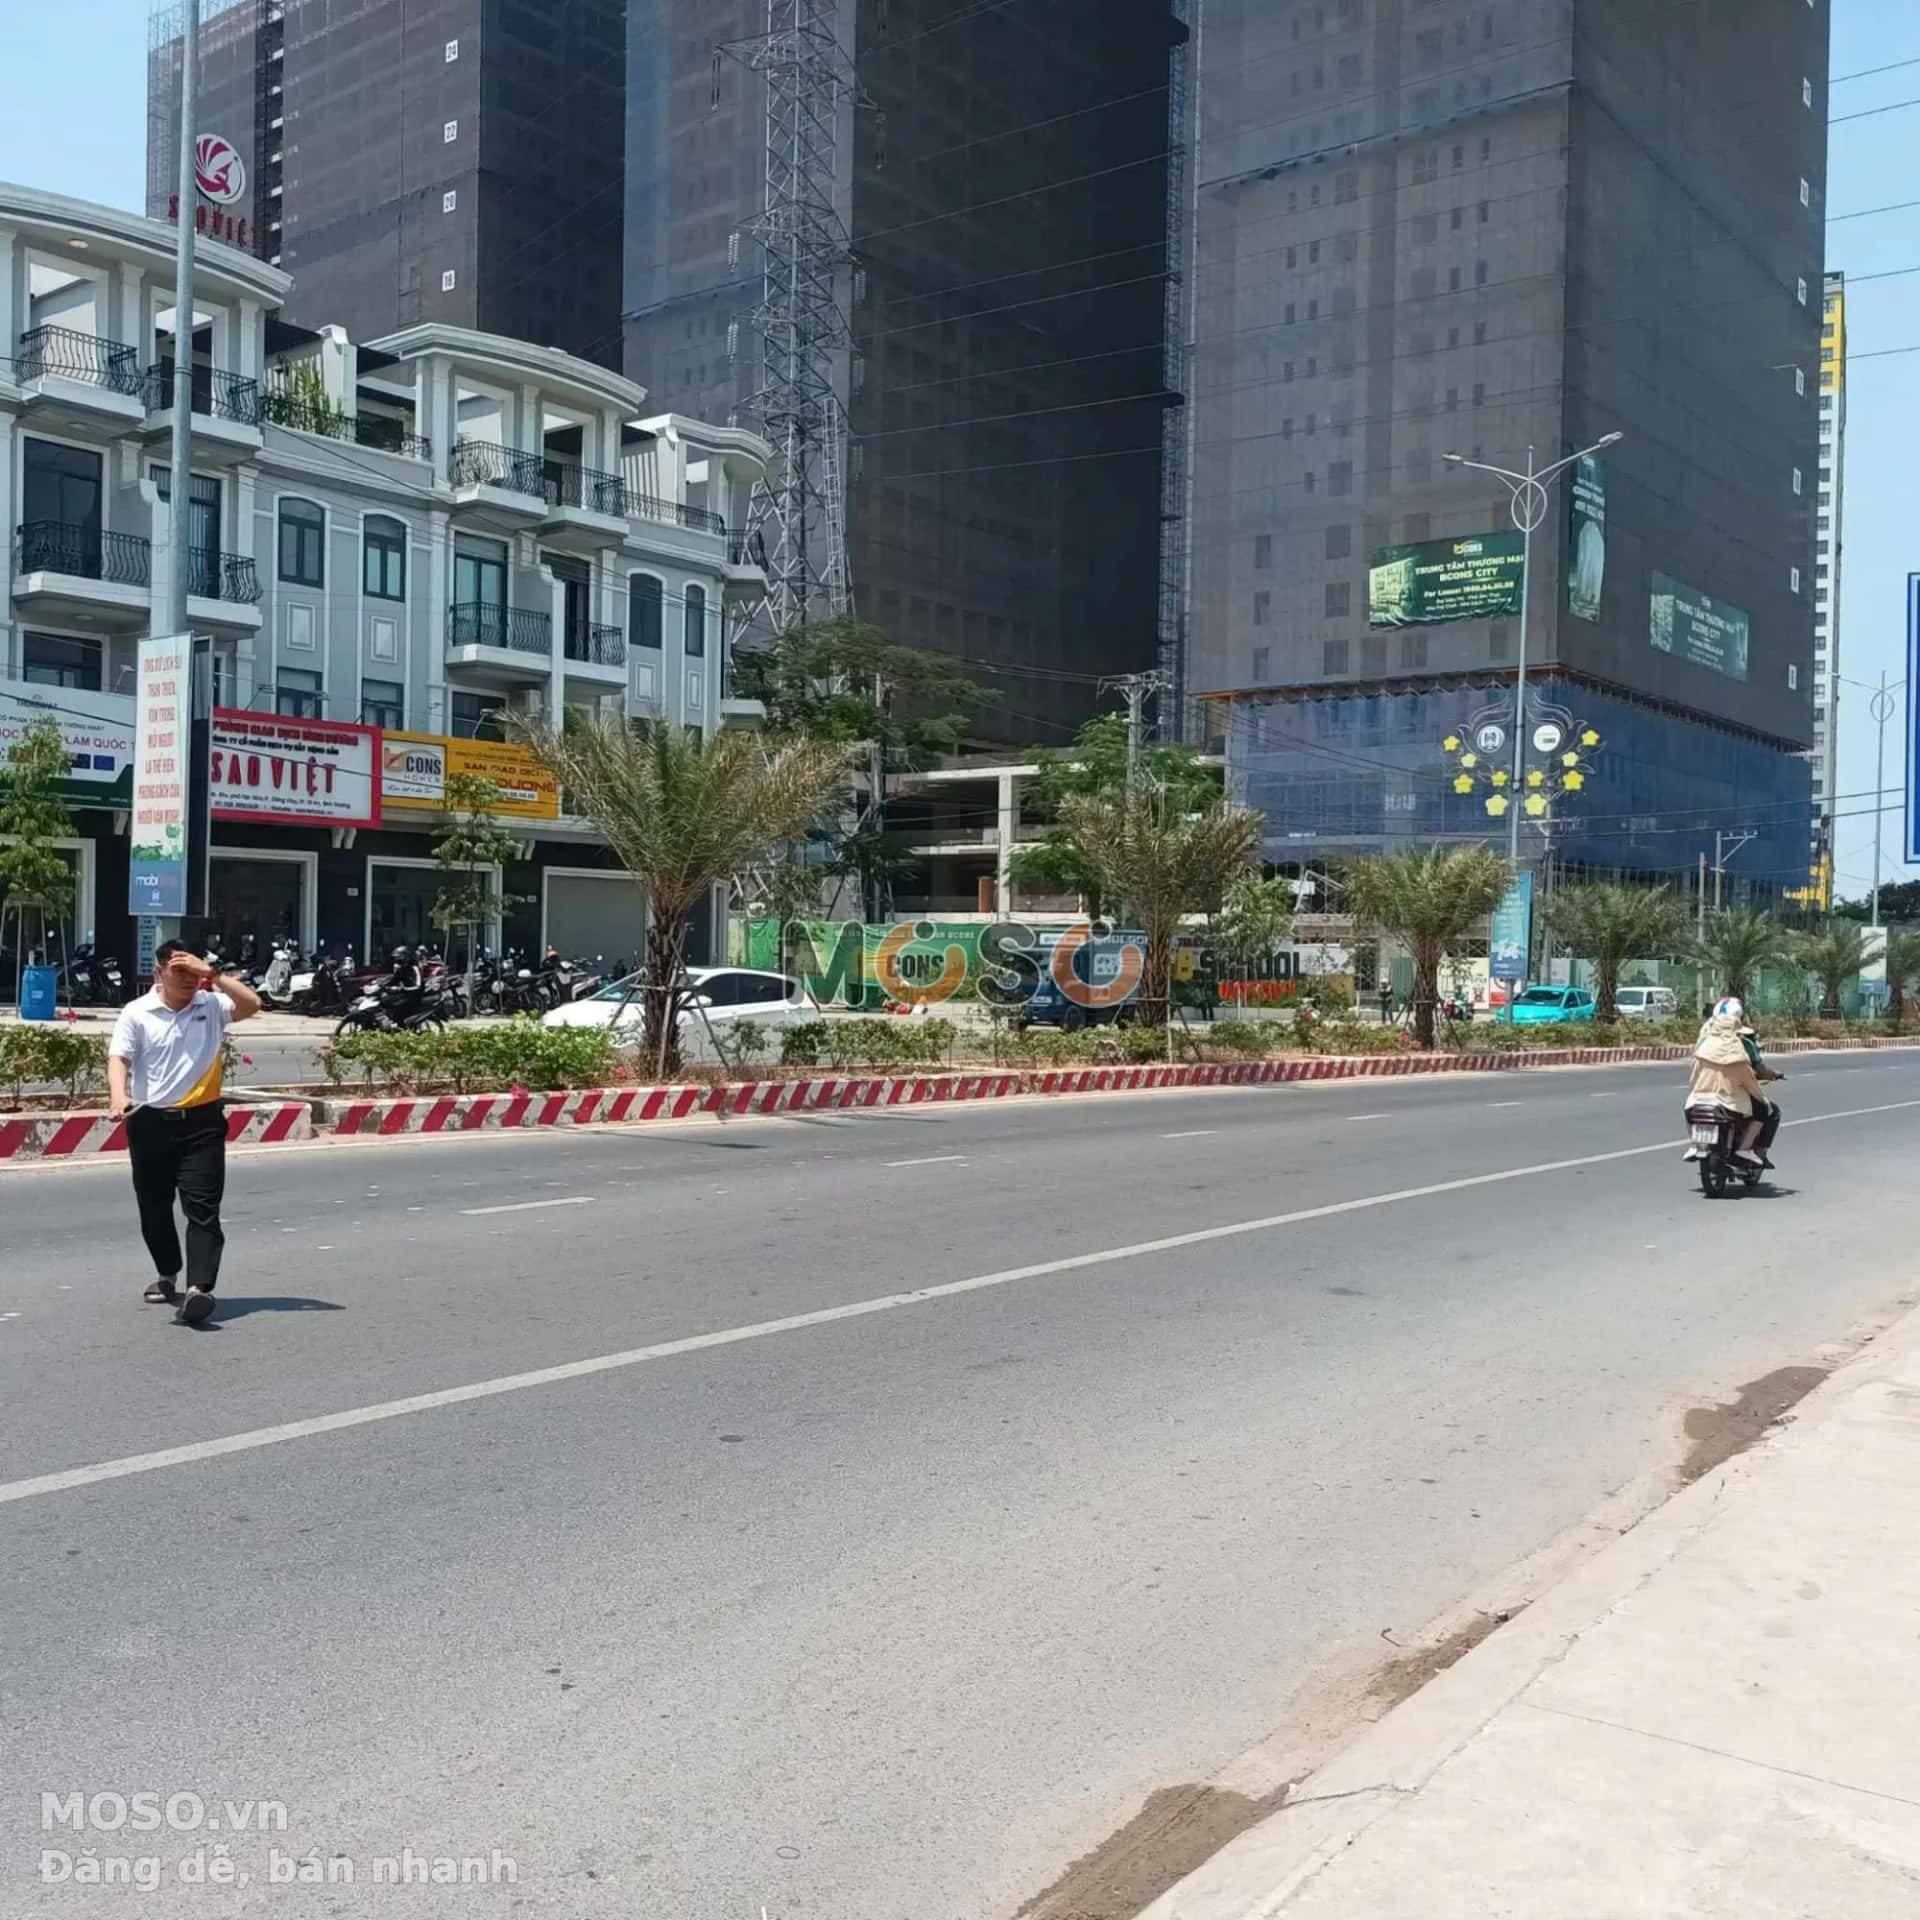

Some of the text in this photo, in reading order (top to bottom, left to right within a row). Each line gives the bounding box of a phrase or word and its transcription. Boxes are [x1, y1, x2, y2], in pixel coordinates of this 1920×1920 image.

[169, 194, 207, 234] SO
[1415, 565, 1443, 575] TRUNG
[1446, 561, 1465, 571] TÂM
[1439, 566, 1499, 582] BCONS CITY
[210, 751, 337, 797] SAO VIỆT
[406, 755, 442, 776] CONS
[1199, 950, 1306, 979] SOOL
